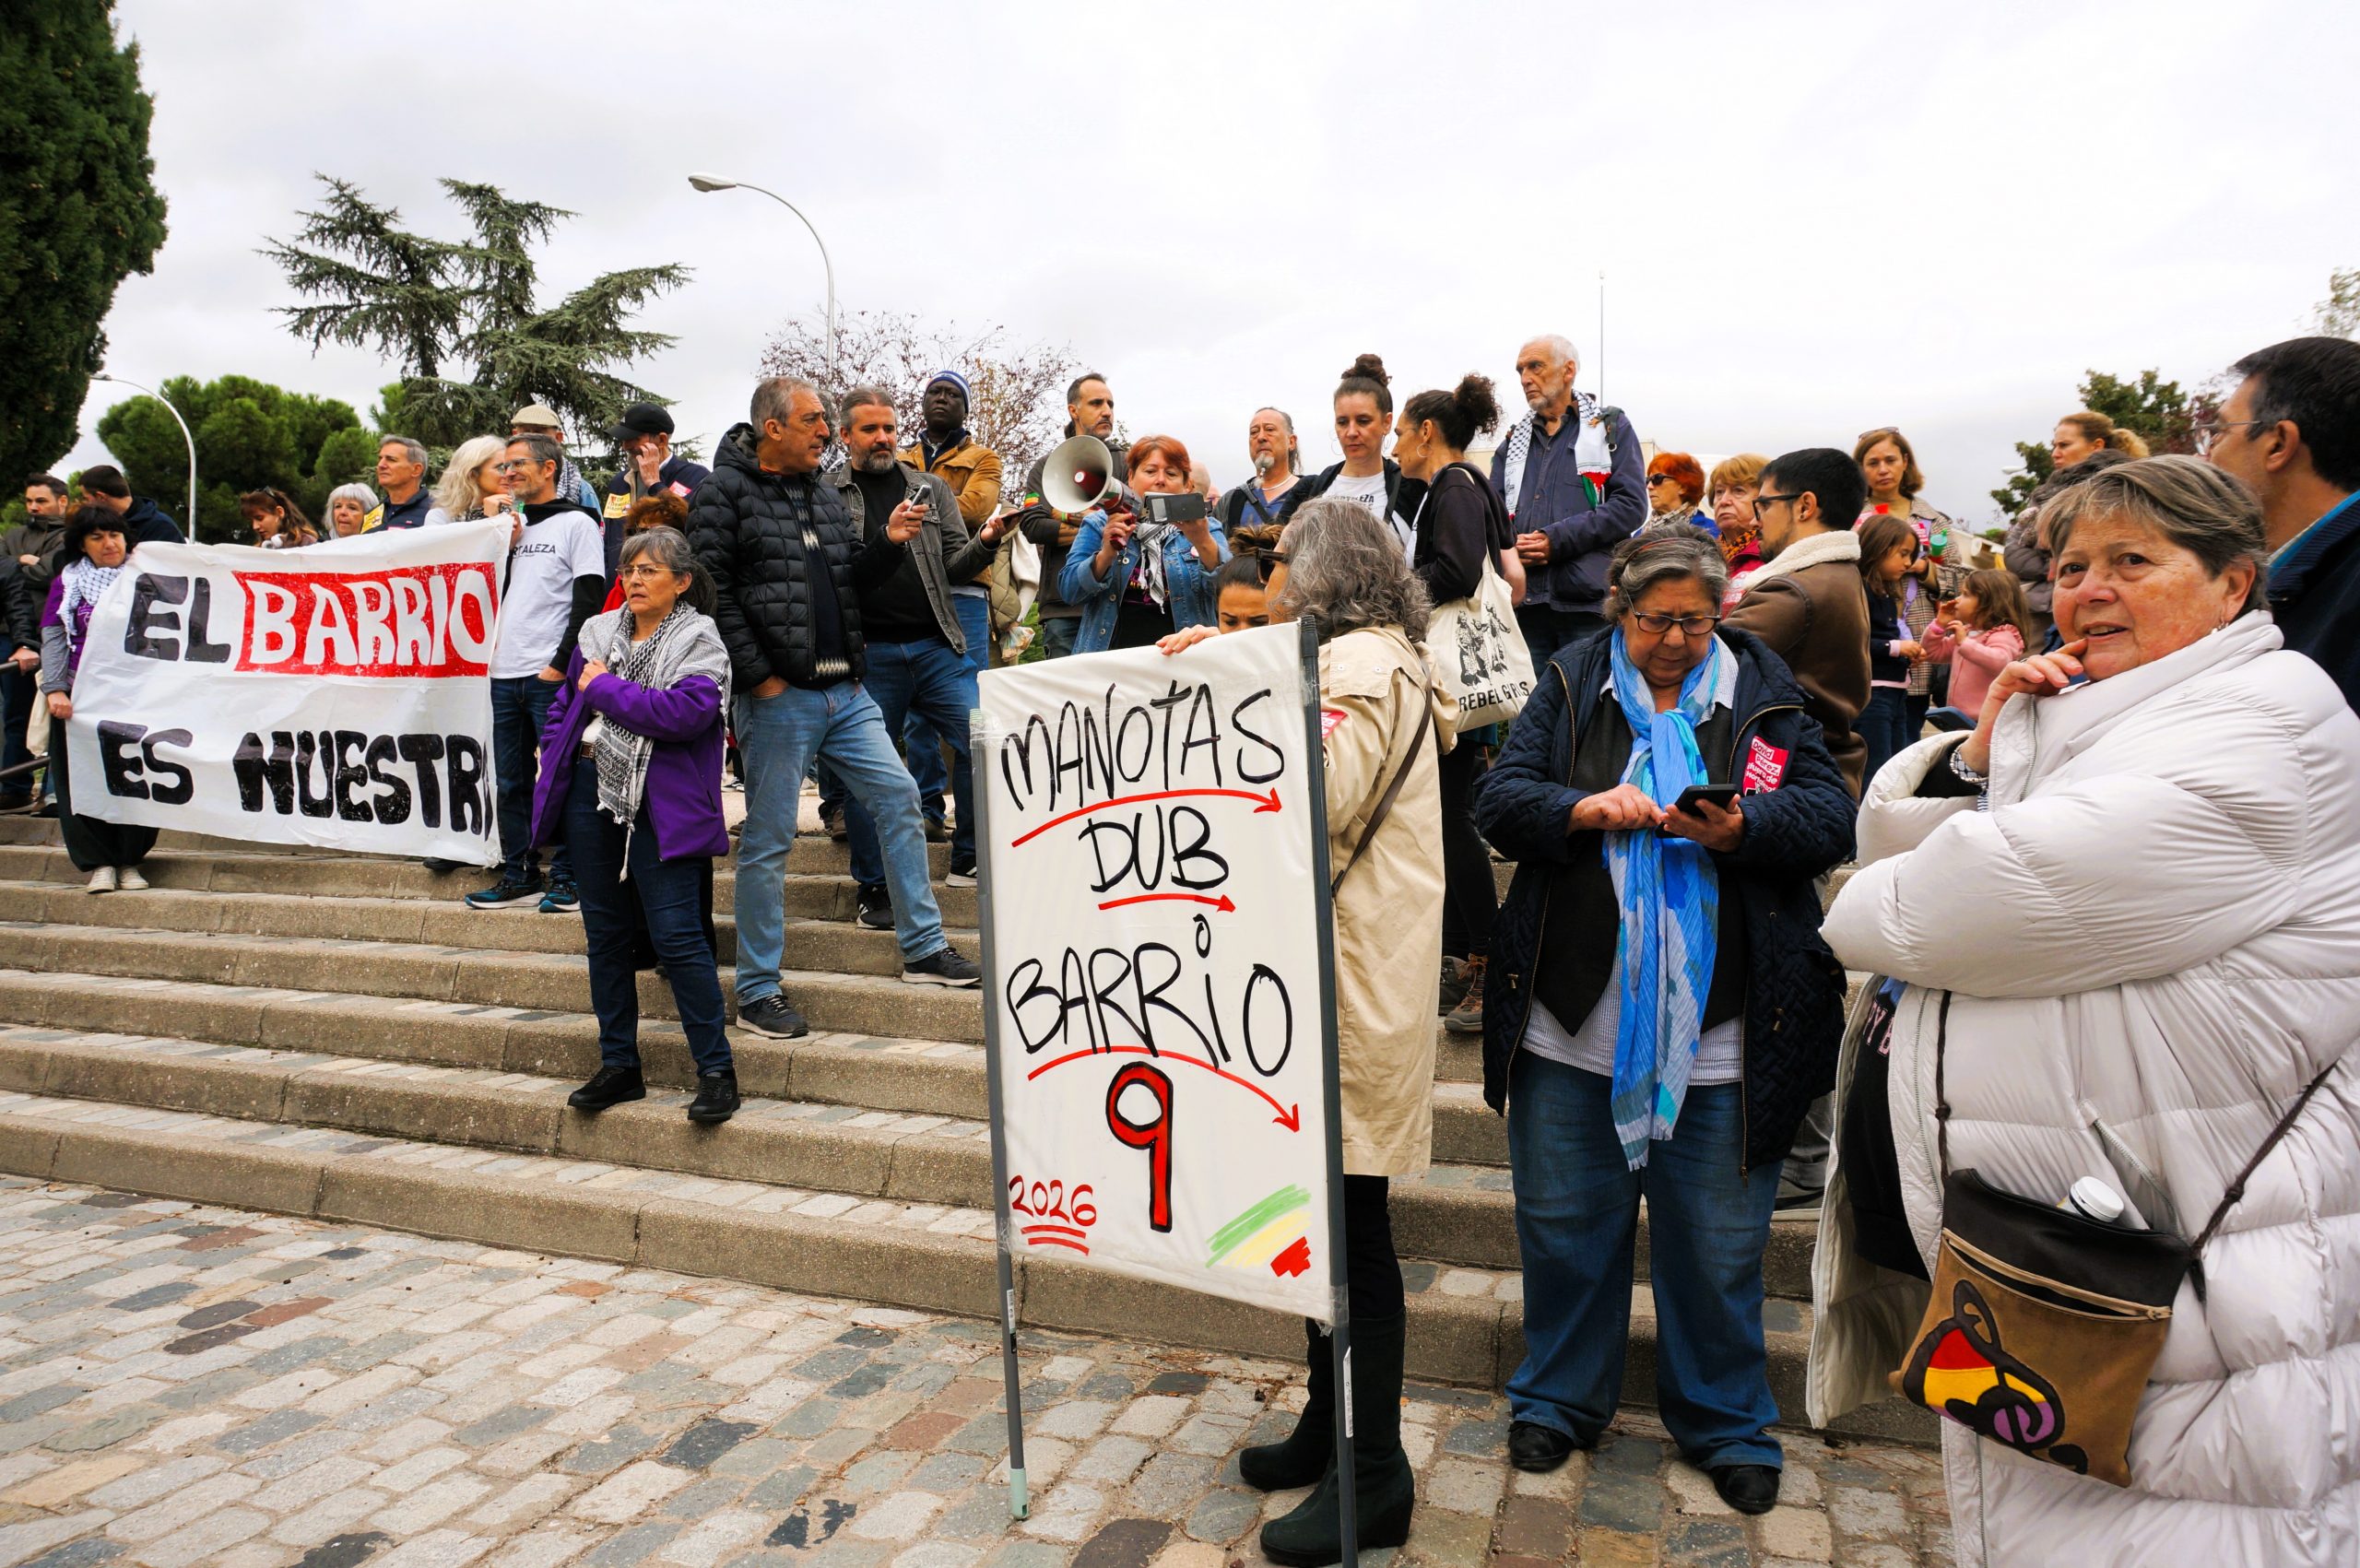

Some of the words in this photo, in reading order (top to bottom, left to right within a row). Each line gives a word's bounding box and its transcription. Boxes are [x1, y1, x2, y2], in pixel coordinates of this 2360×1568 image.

[513, 544, 556, 555] RTALEZA
[124, 573, 232, 664] EL
[246, 569, 495, 666] BARRIO
[1458, 689, 1503, 713] REBEL
[1501, 681, 1530, 700] GRS
[97, 720, 194, 805] ES
[1001, 679, 1284, 812] MANOTAS
[1752, 741, 1773, 758] David
[1765, 774, 1778, 784] de
[1079, 805, 1229, 892] DUB
[1105, 1061, 1174, 1233] 9
[1009, 1174, 1097, 1227] 2026
